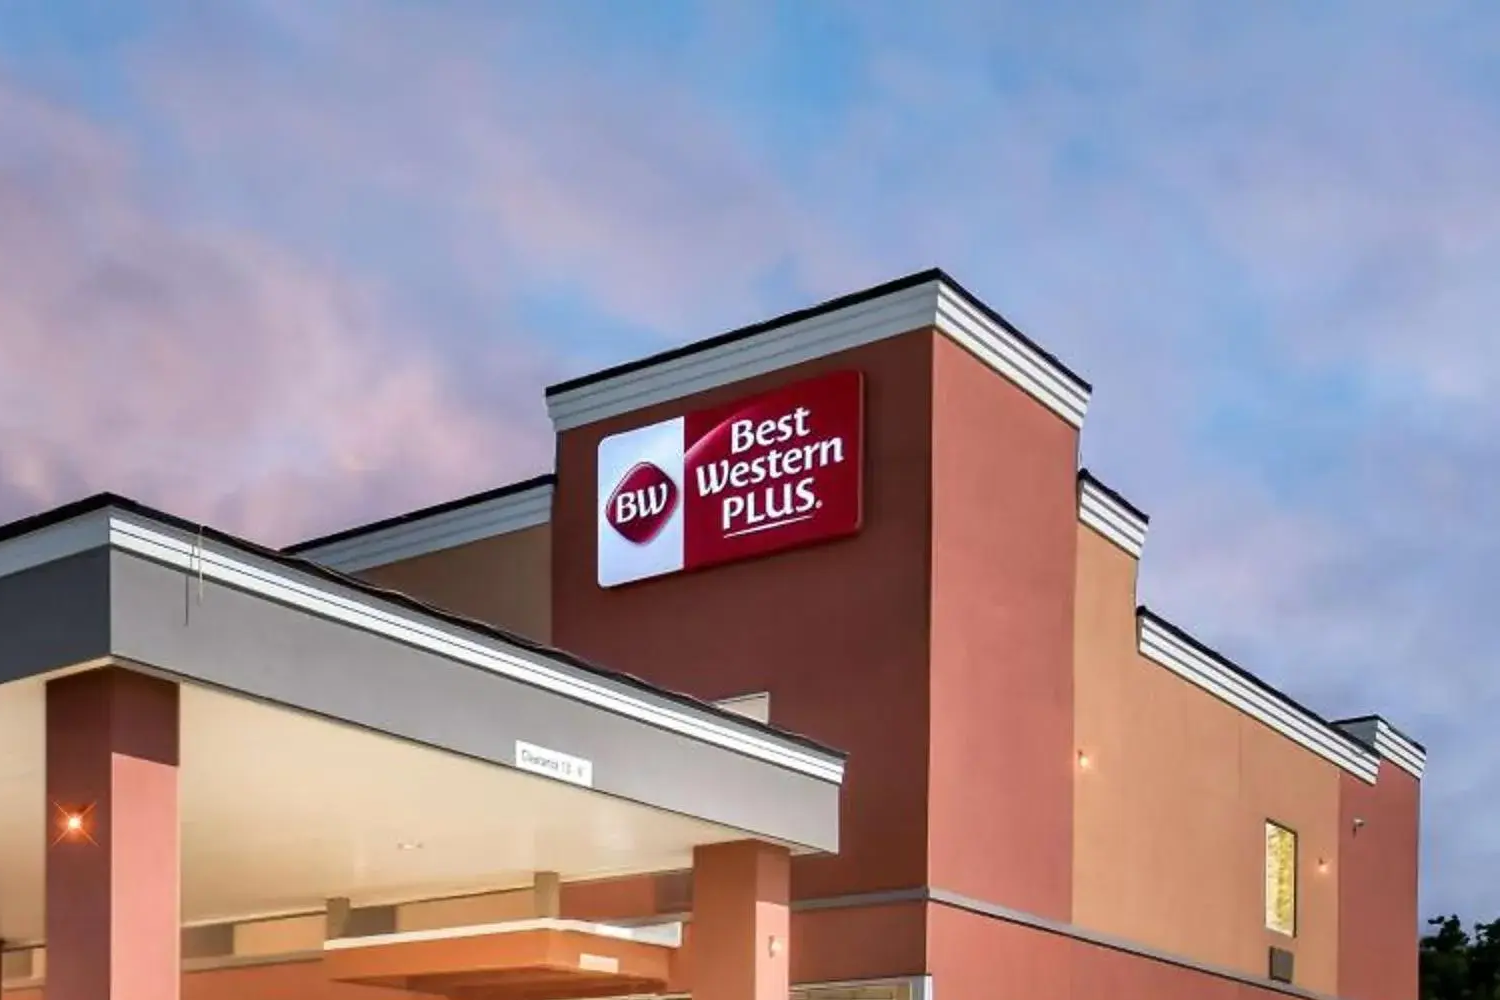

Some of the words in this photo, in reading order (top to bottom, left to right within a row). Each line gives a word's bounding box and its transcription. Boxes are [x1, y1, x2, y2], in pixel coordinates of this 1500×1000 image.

[730, 405, 811, 454] Best
[695, 436, 845, 497] Western
[614, 482, 669, 525] BW
